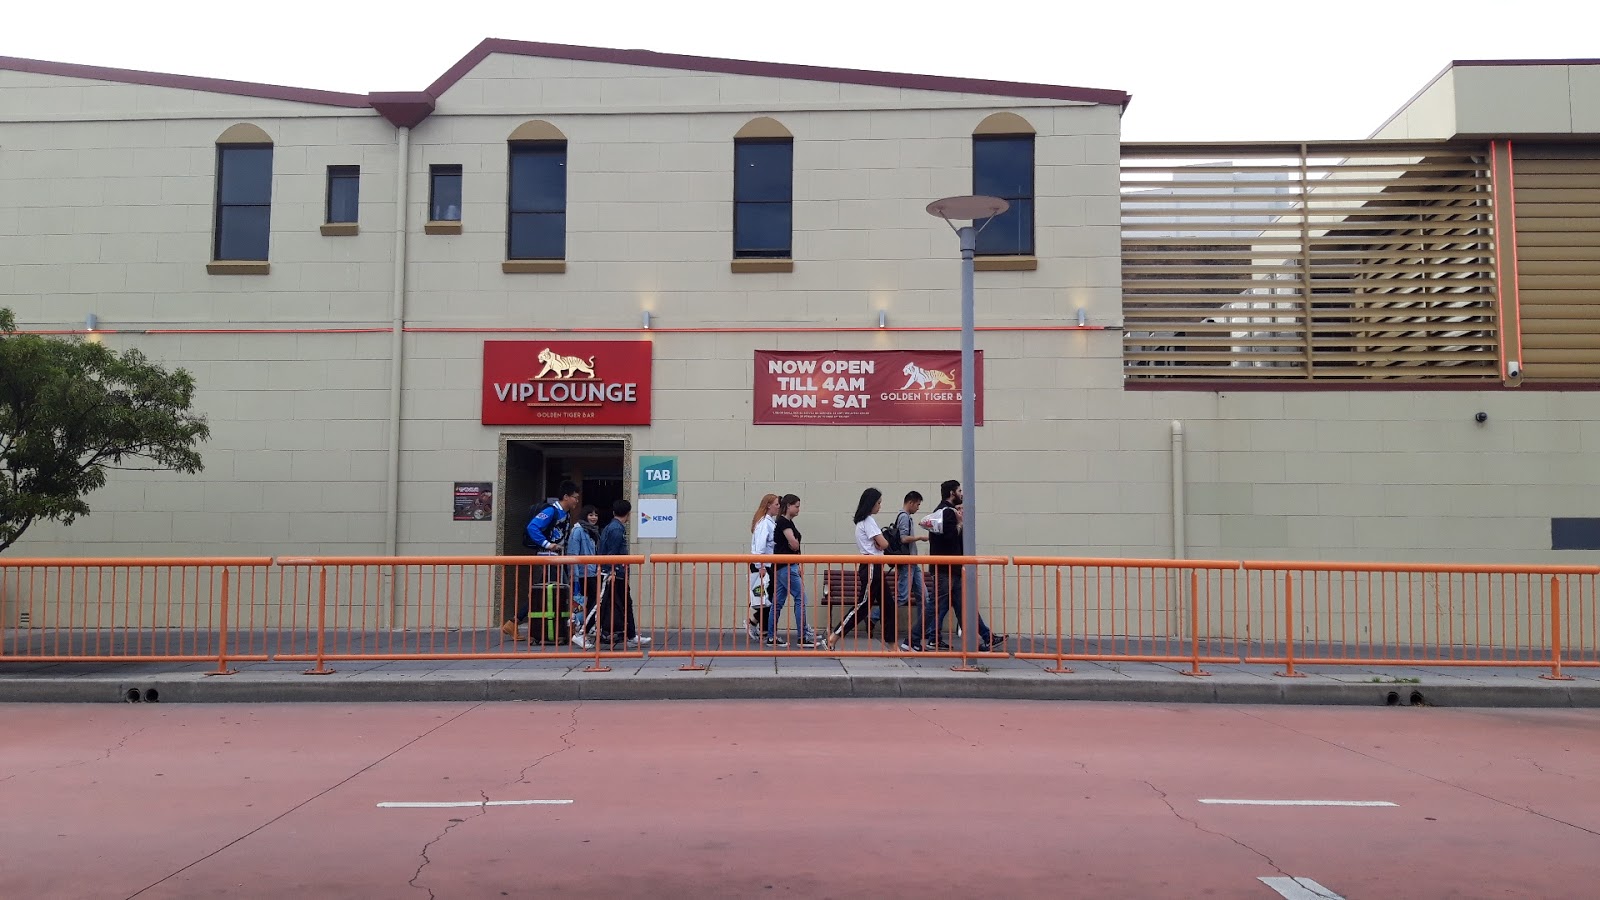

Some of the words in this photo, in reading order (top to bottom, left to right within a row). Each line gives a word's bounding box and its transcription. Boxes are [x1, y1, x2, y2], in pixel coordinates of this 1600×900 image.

[768, 360, 816, 374] NOW
[821, 360, 875, 374] OPEN
[777, 377, 818, 391] TILL
[821, 377, 865, 391] 4AM
[494, 383, 534, 402] VIP
[538, 383, 637, 402] LOUNGE
[880, 392, 921, 402] GOLDEN
[924, 393, 954, 402] TIGER
[956, 393, 977, 402] BR
[772, 394, 816, 408] MON
[832, 394, 870, 408] SAT
[645, 469, 671, 481] TAB
